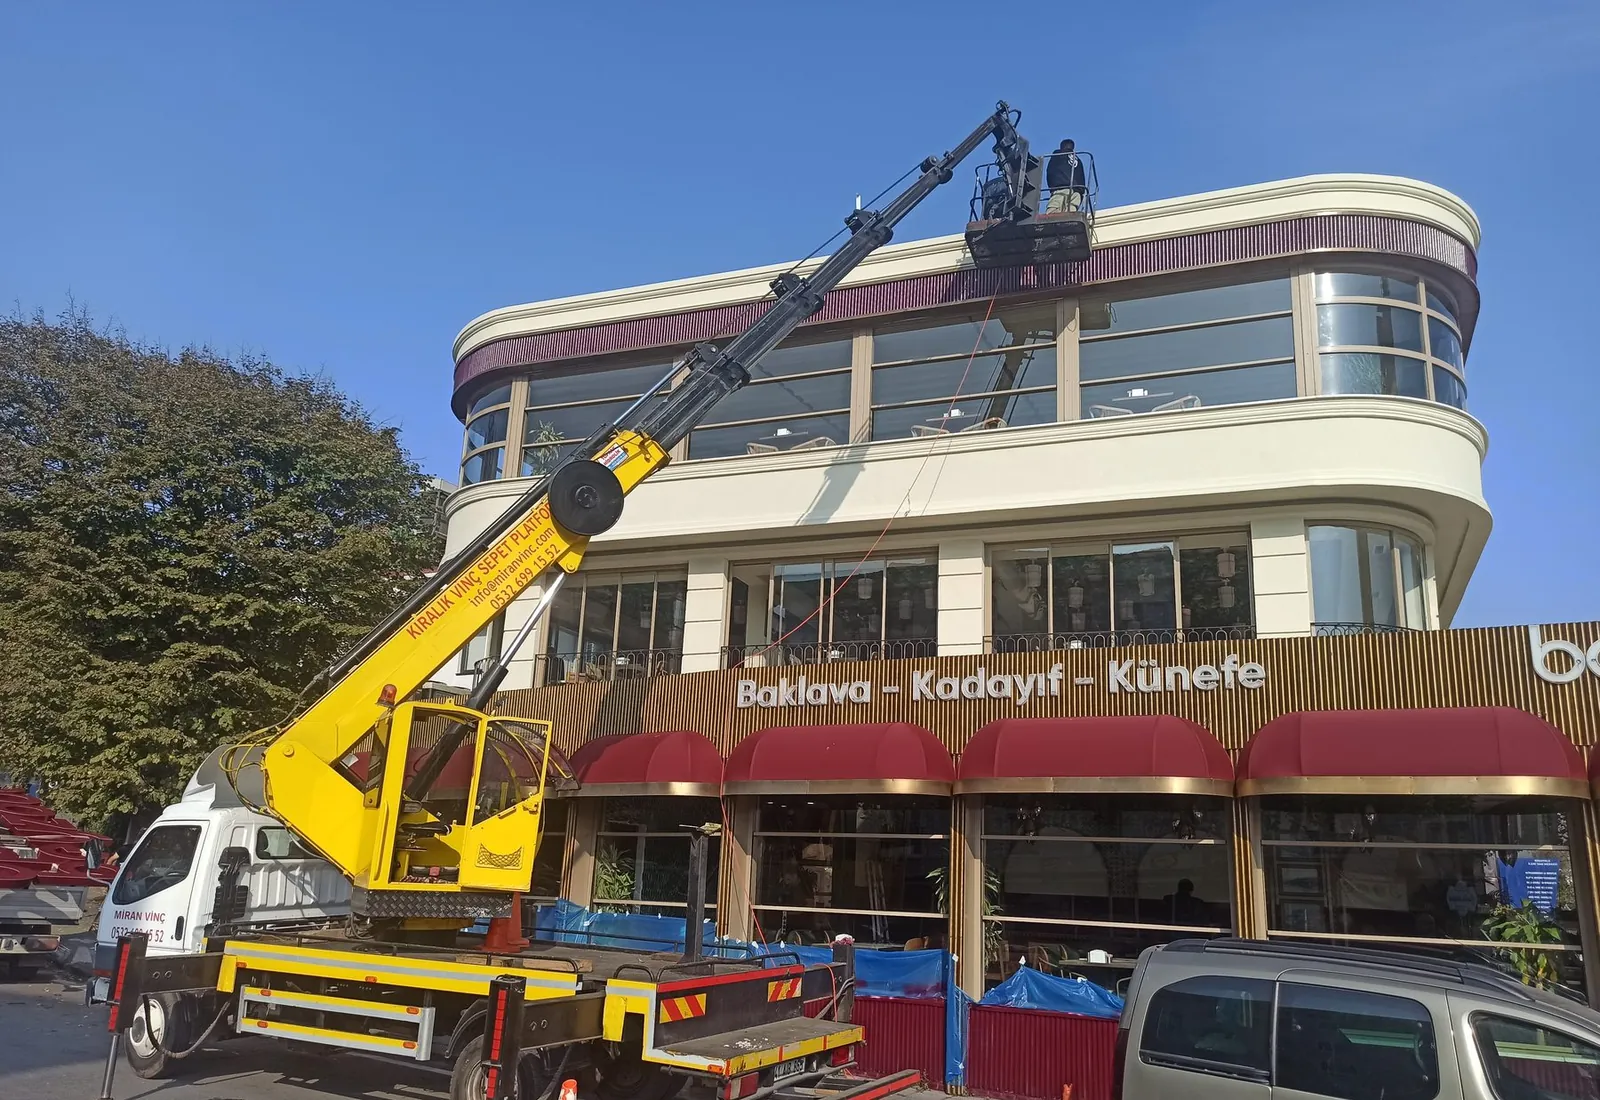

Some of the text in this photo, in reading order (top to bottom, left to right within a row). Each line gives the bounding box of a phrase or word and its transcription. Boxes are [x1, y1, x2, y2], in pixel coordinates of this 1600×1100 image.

[406, 594, 455, 639] KIRALIK
[477, 540, 512, 575] SEPET
[468, 527, 555, 607] info@miranvinc.com
[490, 544, 560, 609] 0532 699 15 52
[737, 676, 870, 708] Baklava
[913, 666, 1063, 706] Kadayıf
[1108, 654, 1266, 693] Künefe
[114, 910, 166, 924] MİRAN VİNÇ
[155, 930, 164, 942] 52
